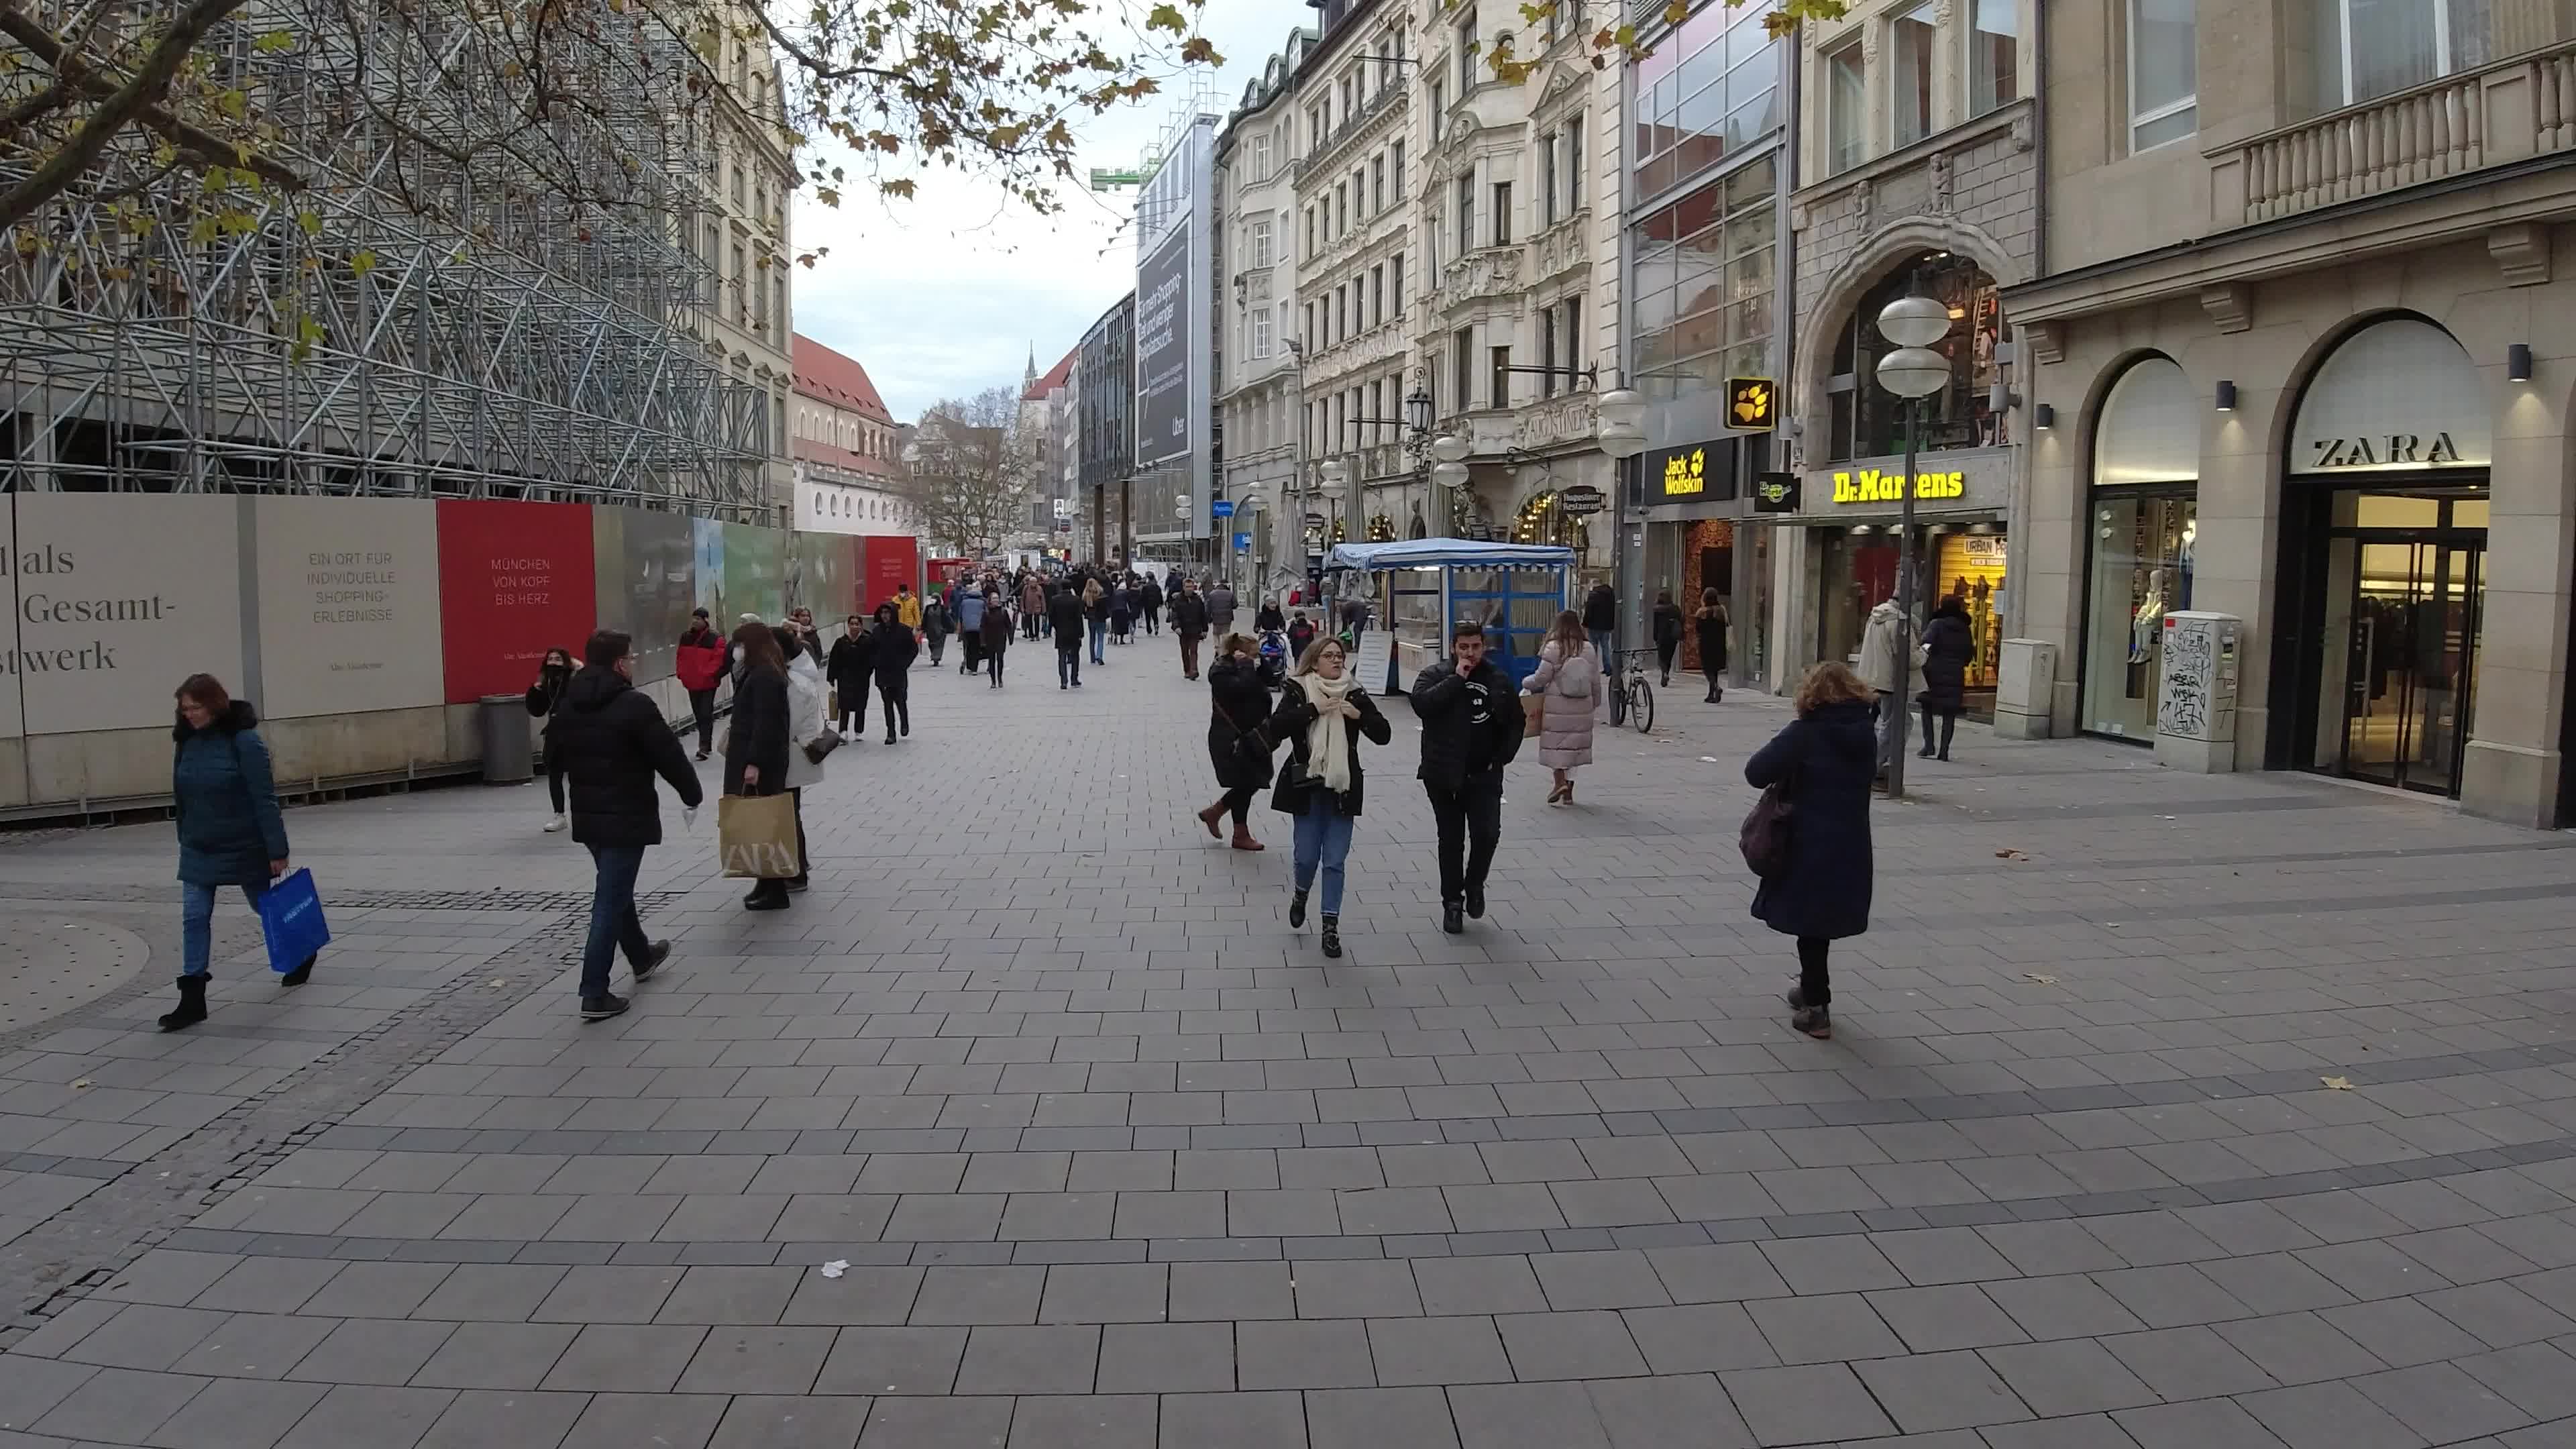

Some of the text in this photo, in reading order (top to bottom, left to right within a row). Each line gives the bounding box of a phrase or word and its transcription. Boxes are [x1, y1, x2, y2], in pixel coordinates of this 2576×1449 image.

[1173, 416, 1185, 437] Uber
[2312, 432, 2463, 468] ZARA
[1665, 454, 1687, 476] Jack
[1665, 473, 1703, 495] Wolfskin
[1966, 540, 1992, 553] URBAN
[23, 543, 74, 574] als
[309, 553, 330, 565] EIN
[335, 553, 361, 565] ORT
[491, 557, 550, 570] MÜNCHEN
[307, 572, 396, 585] INDIVIDUELLE
[493, 576, 551, 587] VON KOPF
[316, 590, 390, 604] SHOPPING-
[496, 593, 549, 605] BIS HERZ
[23, 593, 176, 623] Gesamt-
[313, 608, 392, 623] ERLEBNISSE
